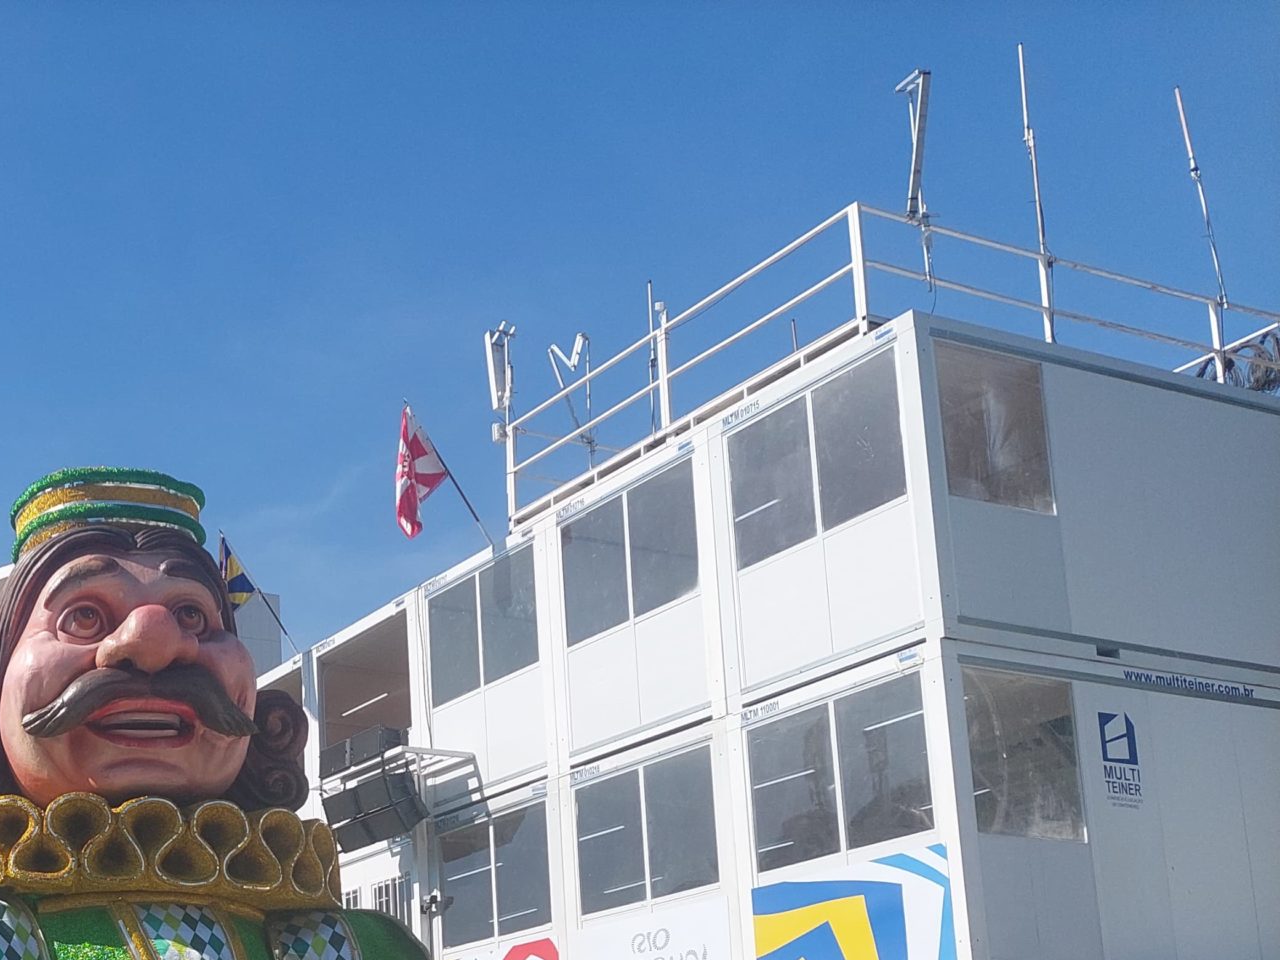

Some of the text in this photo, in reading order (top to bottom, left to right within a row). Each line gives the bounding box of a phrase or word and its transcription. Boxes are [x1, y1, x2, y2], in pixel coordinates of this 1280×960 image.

[1123, 670, 1255, 698] www.multiteiner.com.br
[1103, 765, 1141, 783] MULTI
[1105, 780, 1142, 797] TEINER
